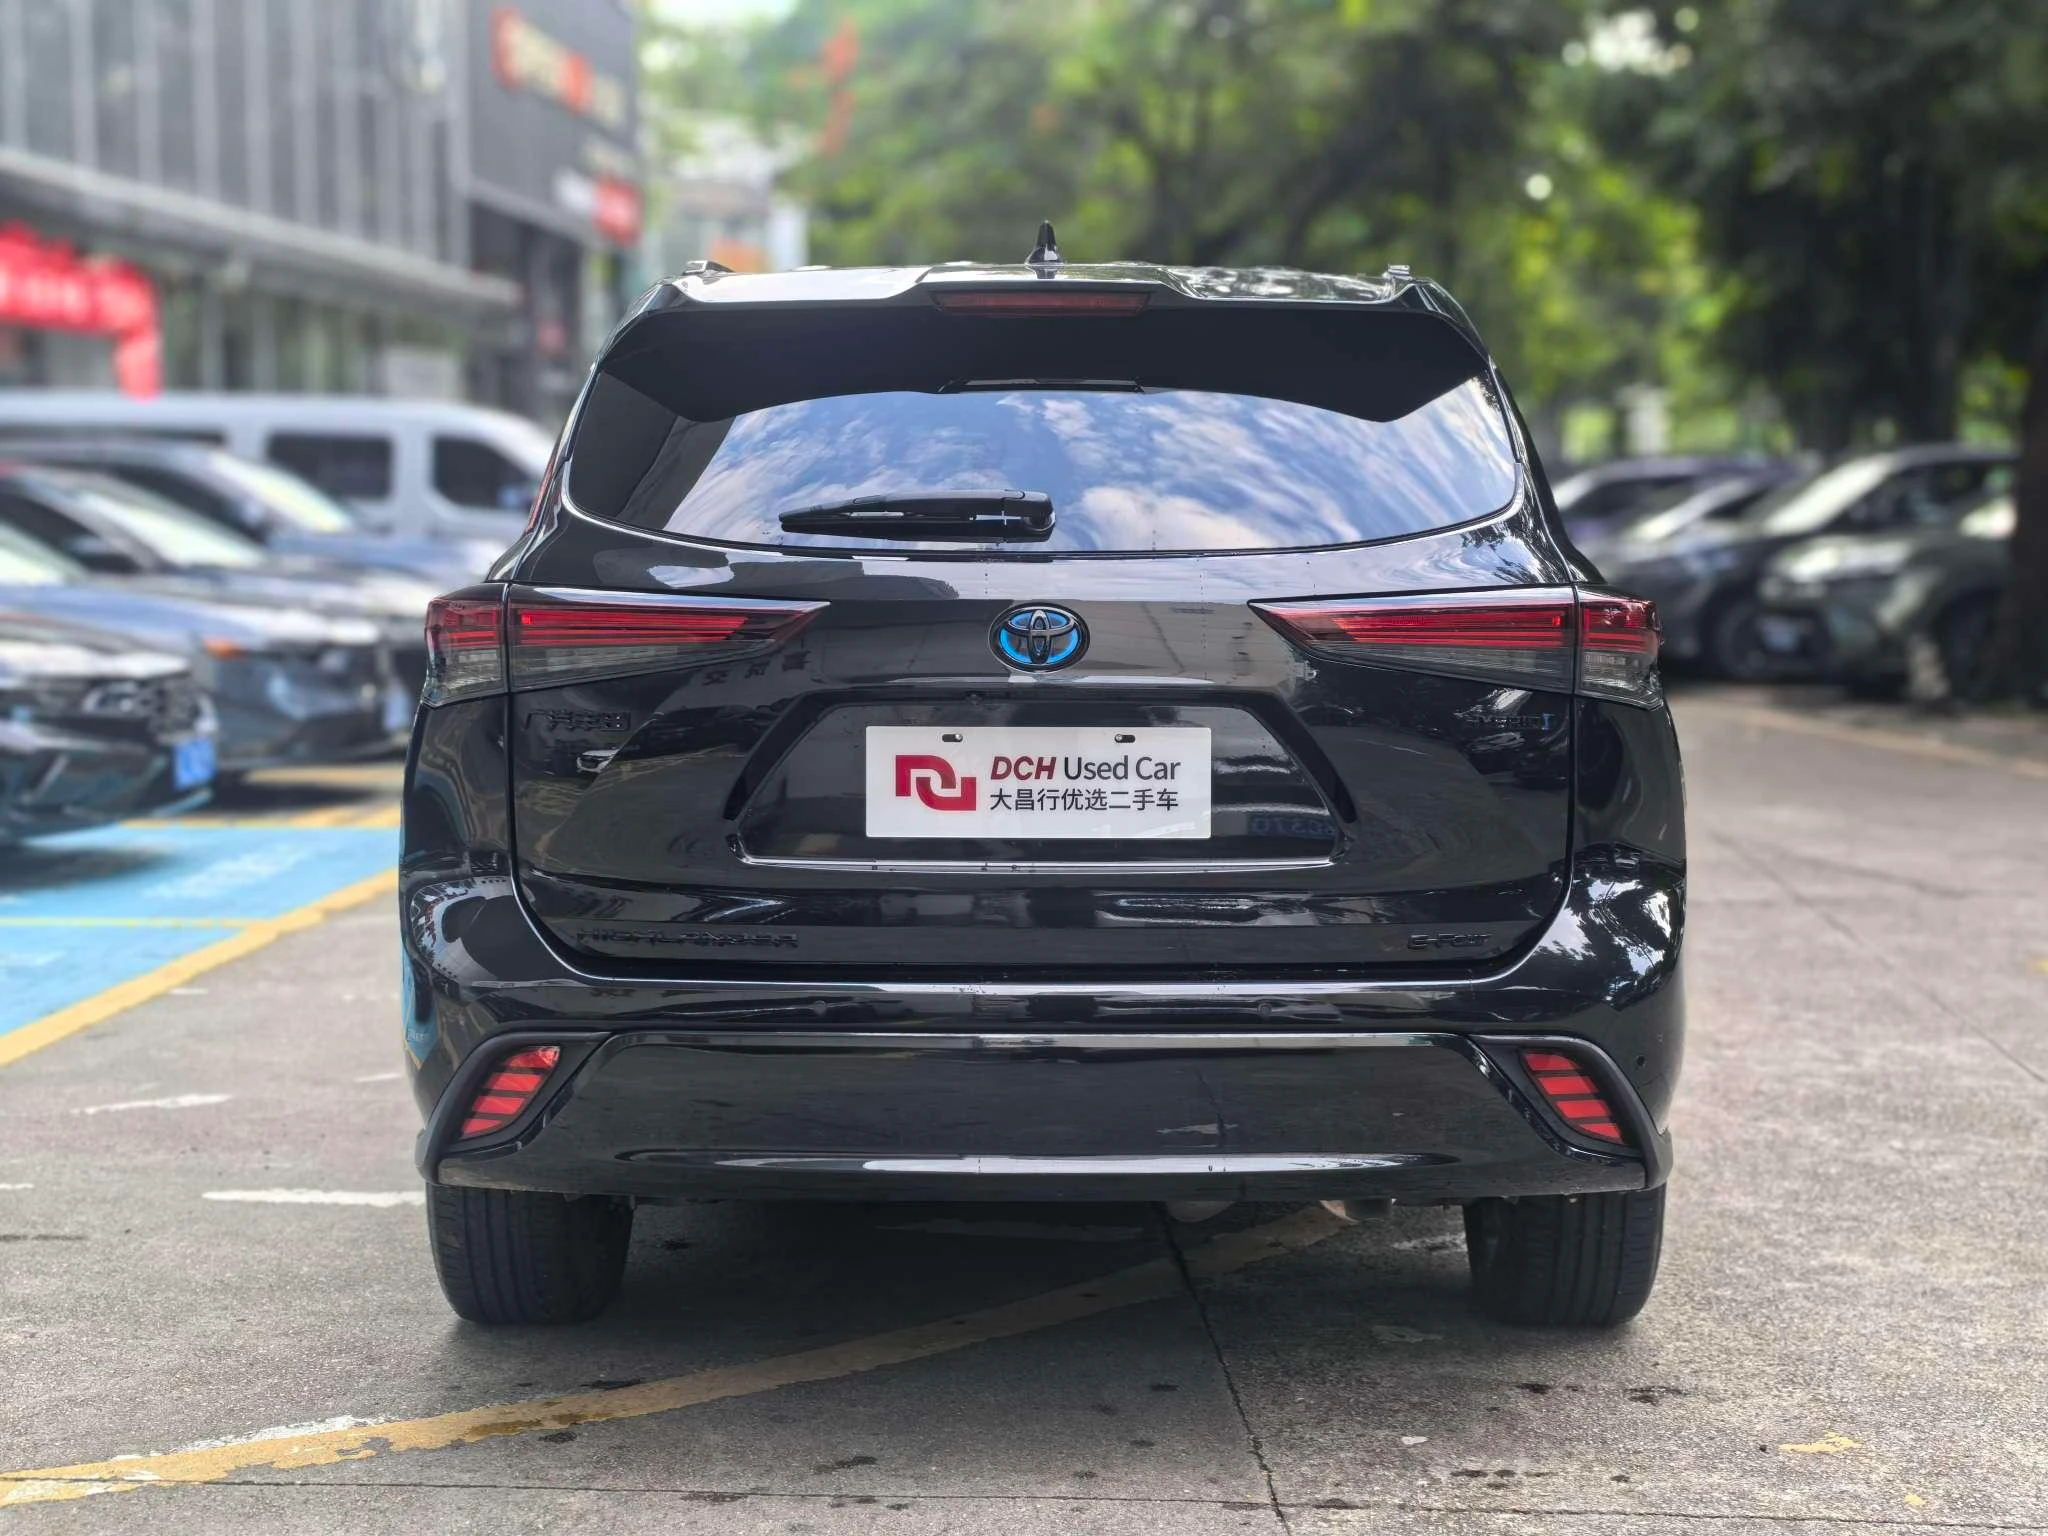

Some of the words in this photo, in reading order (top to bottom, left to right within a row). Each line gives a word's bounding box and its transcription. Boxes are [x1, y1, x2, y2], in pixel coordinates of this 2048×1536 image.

[990, 755, 1057, 781] DCH
[1063, 755, 1129, 781] Used
[1135, 756, 1181, 781] Car
[989, 787, 1179, 812] 大昌行优选二手车
